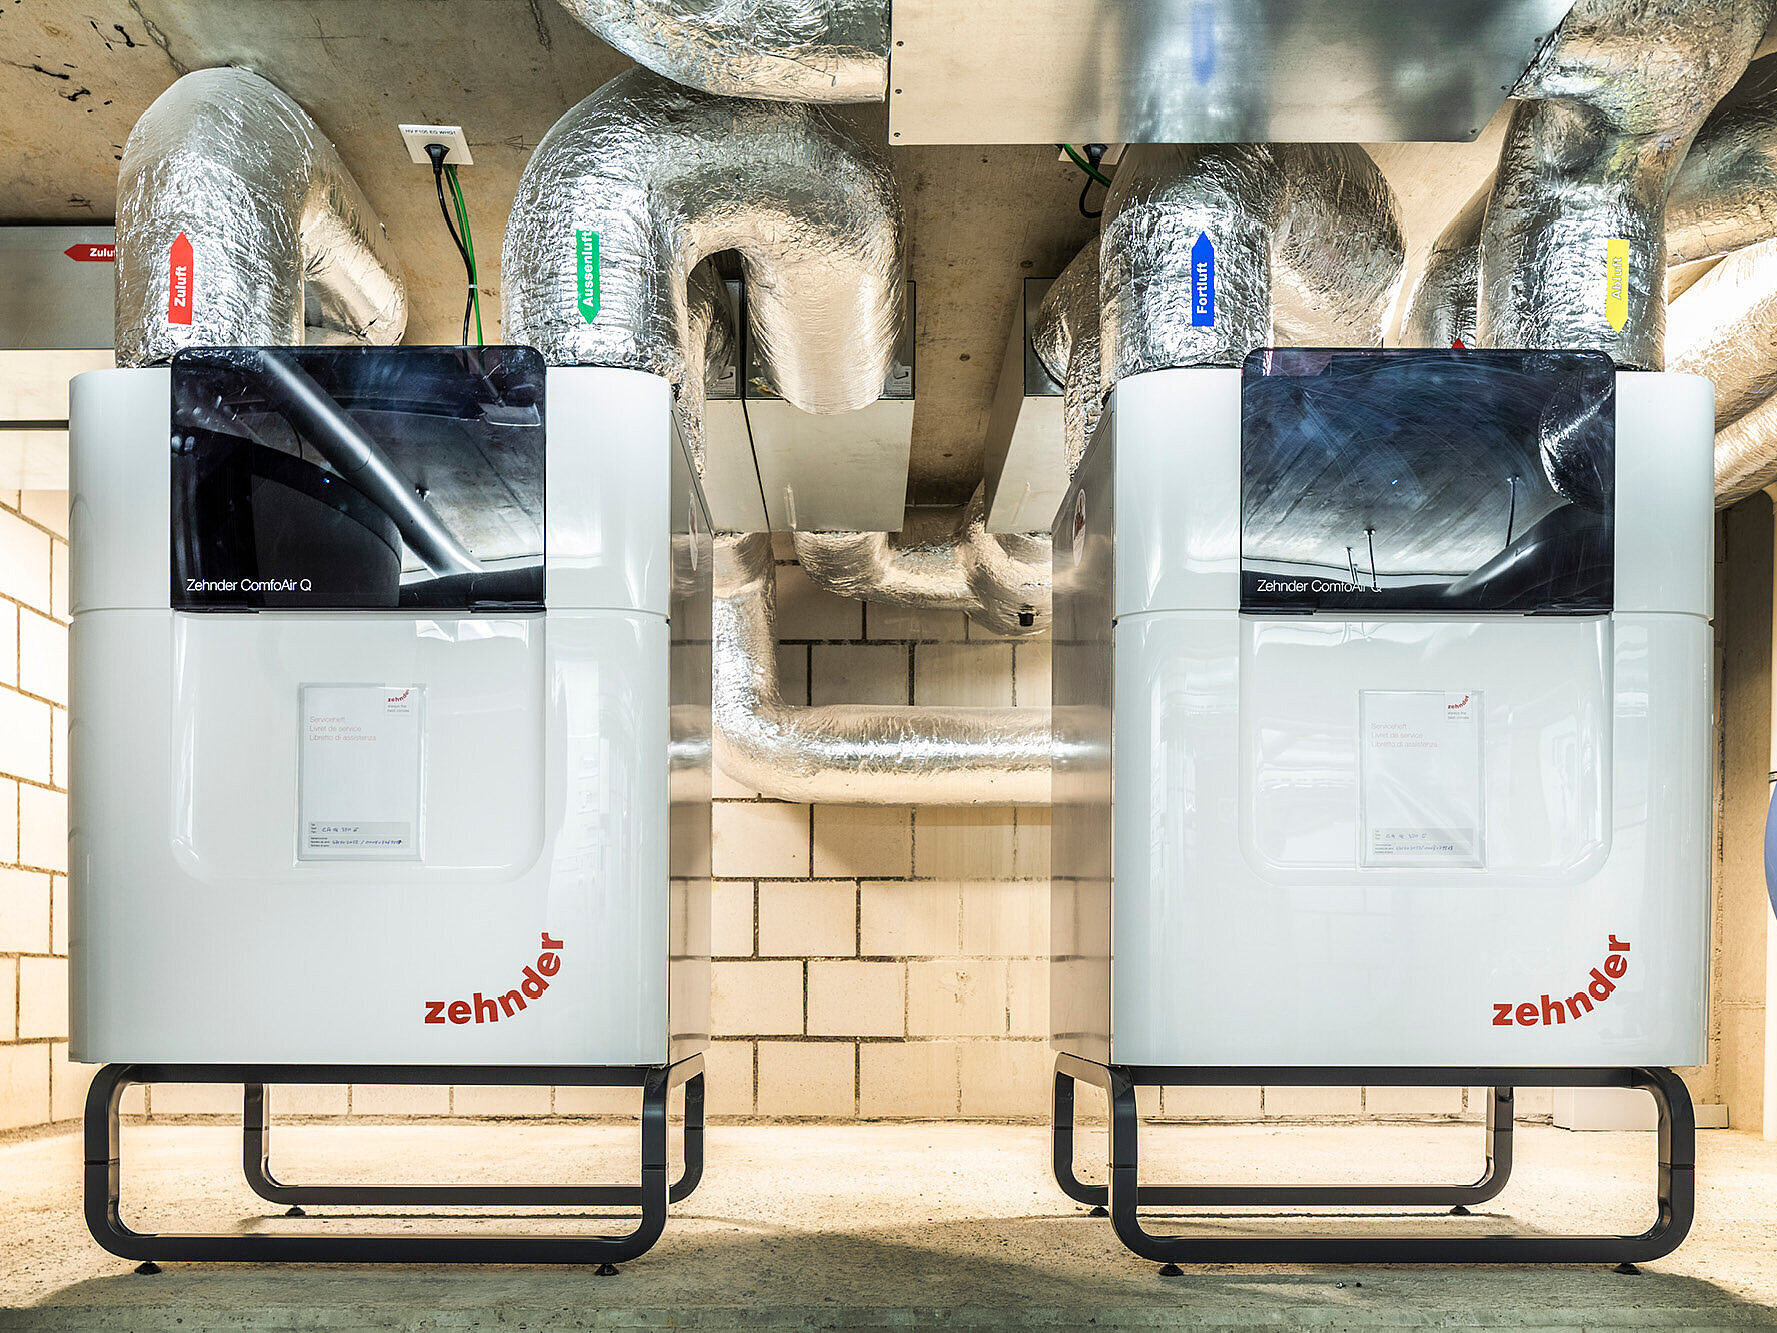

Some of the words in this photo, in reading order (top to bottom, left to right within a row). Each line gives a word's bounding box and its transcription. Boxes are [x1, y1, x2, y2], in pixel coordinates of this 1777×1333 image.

[174, 266, 187, 308] Zuluft
[581, 228, 594, 307] Aussenluft
[1196, 261, 1208, 314] Fortluft
[1611, 256, 1623, 300] Abluft
[186, 578, 238, 592] Zehnder
[240, 578, 298, 592] ComfoAir
[299, 578, 312, 592] Q
[1256, 579, 1310, 592] Zehnder
[424, 932, 564, 1025] zehnder
[1492, 934, 1630, 1026] zehnder
